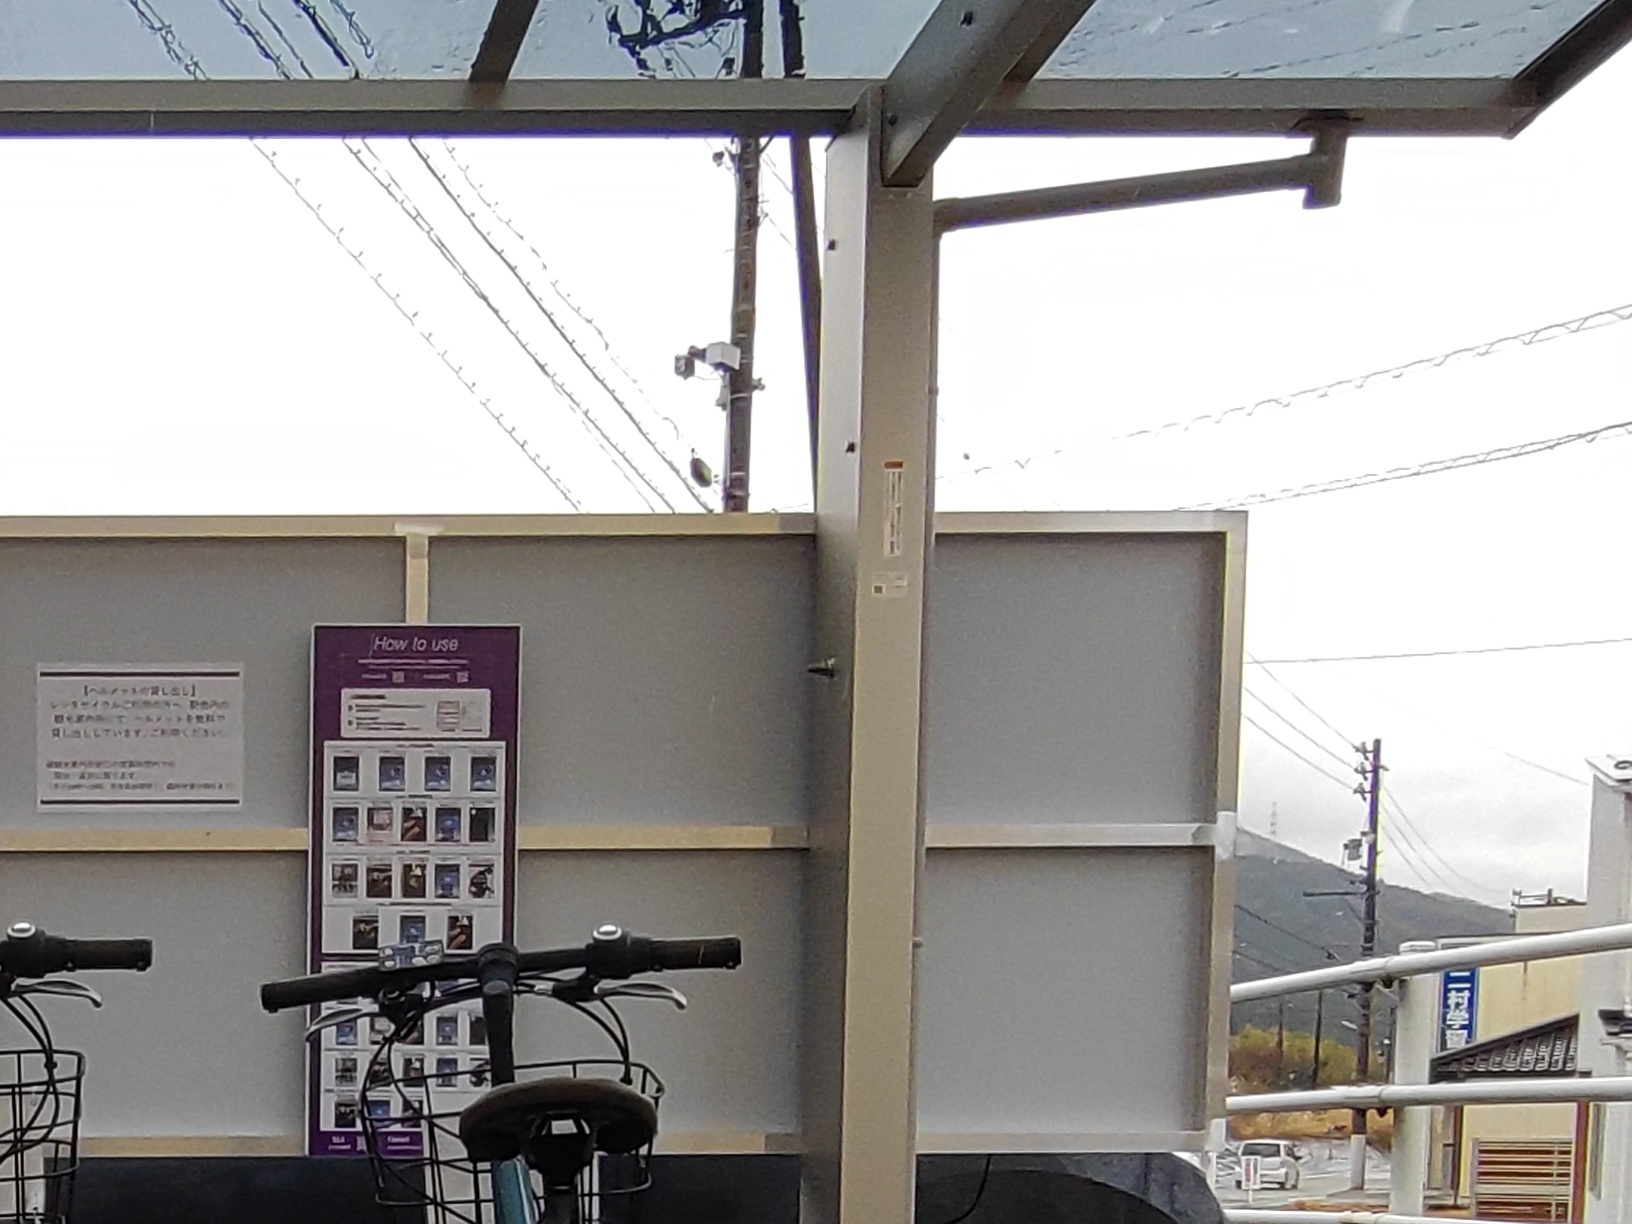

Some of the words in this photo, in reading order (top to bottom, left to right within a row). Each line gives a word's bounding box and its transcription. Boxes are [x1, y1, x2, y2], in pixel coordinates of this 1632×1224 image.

[373, 636, 409, 651] How
[412, 636, 427, 651] to
[432, 638, 459, 652] use
